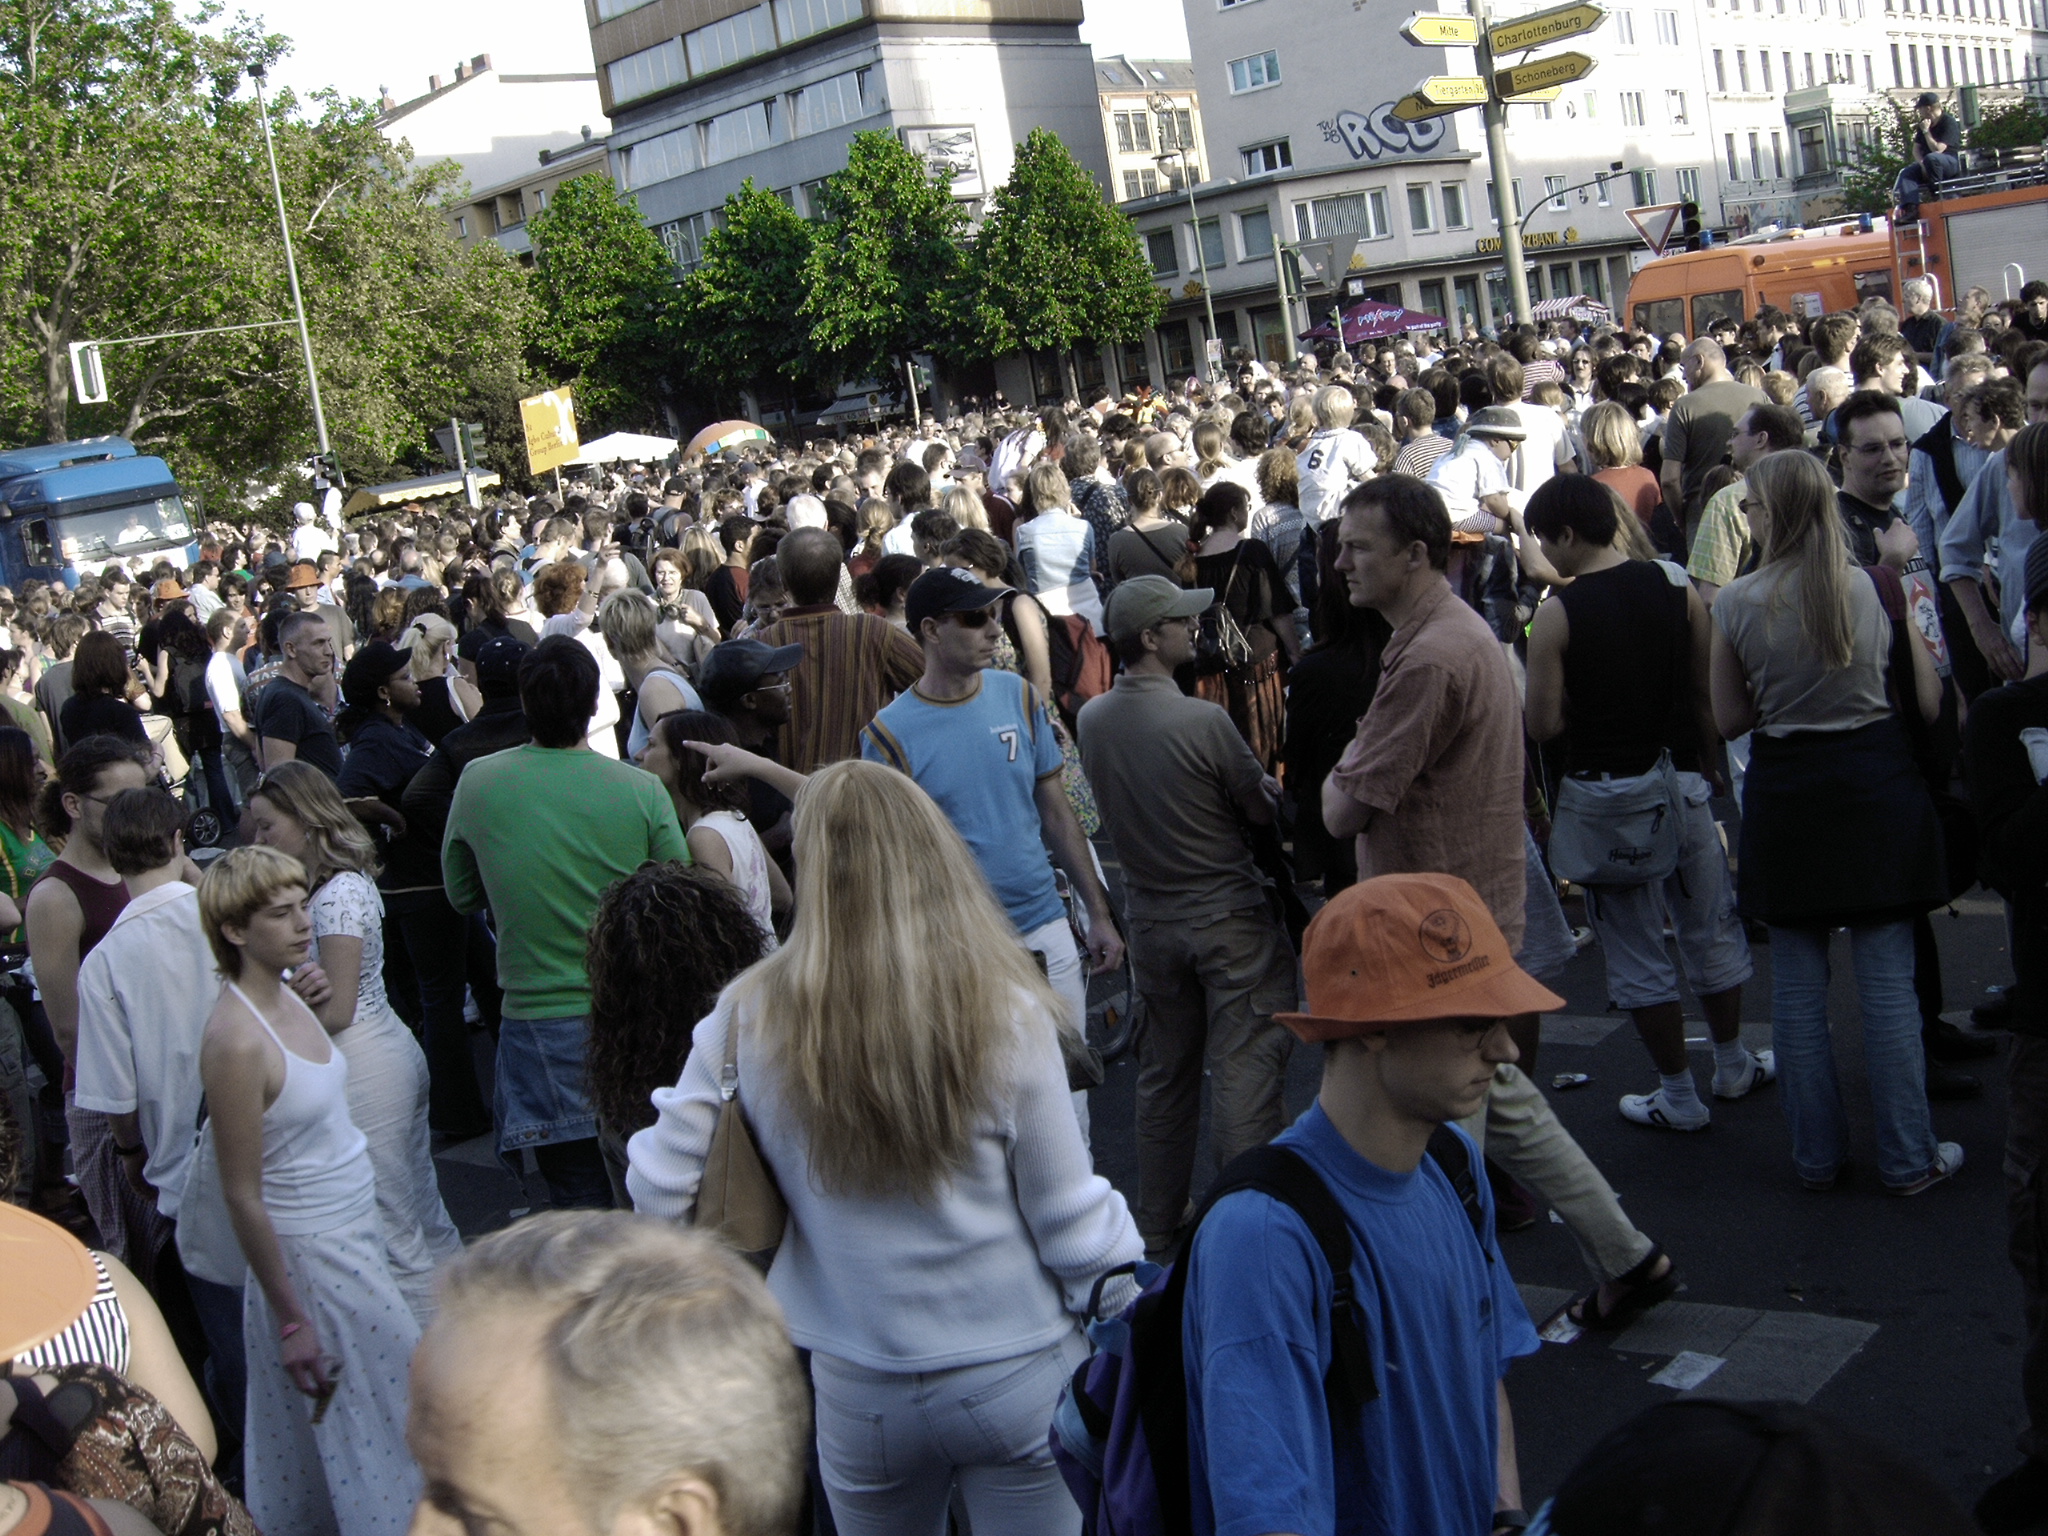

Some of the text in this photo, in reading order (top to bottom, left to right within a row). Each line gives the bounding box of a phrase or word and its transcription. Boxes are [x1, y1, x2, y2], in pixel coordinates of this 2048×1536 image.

[1439, 24, 1459, 37] Mitte
[1497, 16, 1582, 47] Charlottenburg
[1514, 61, 1576, 86] Schöneberg
[1435, 84, 1473, 97] Tiergarten
[1307, 449, 1324, 469] 6
[998, 730, 1018, 762] 7
